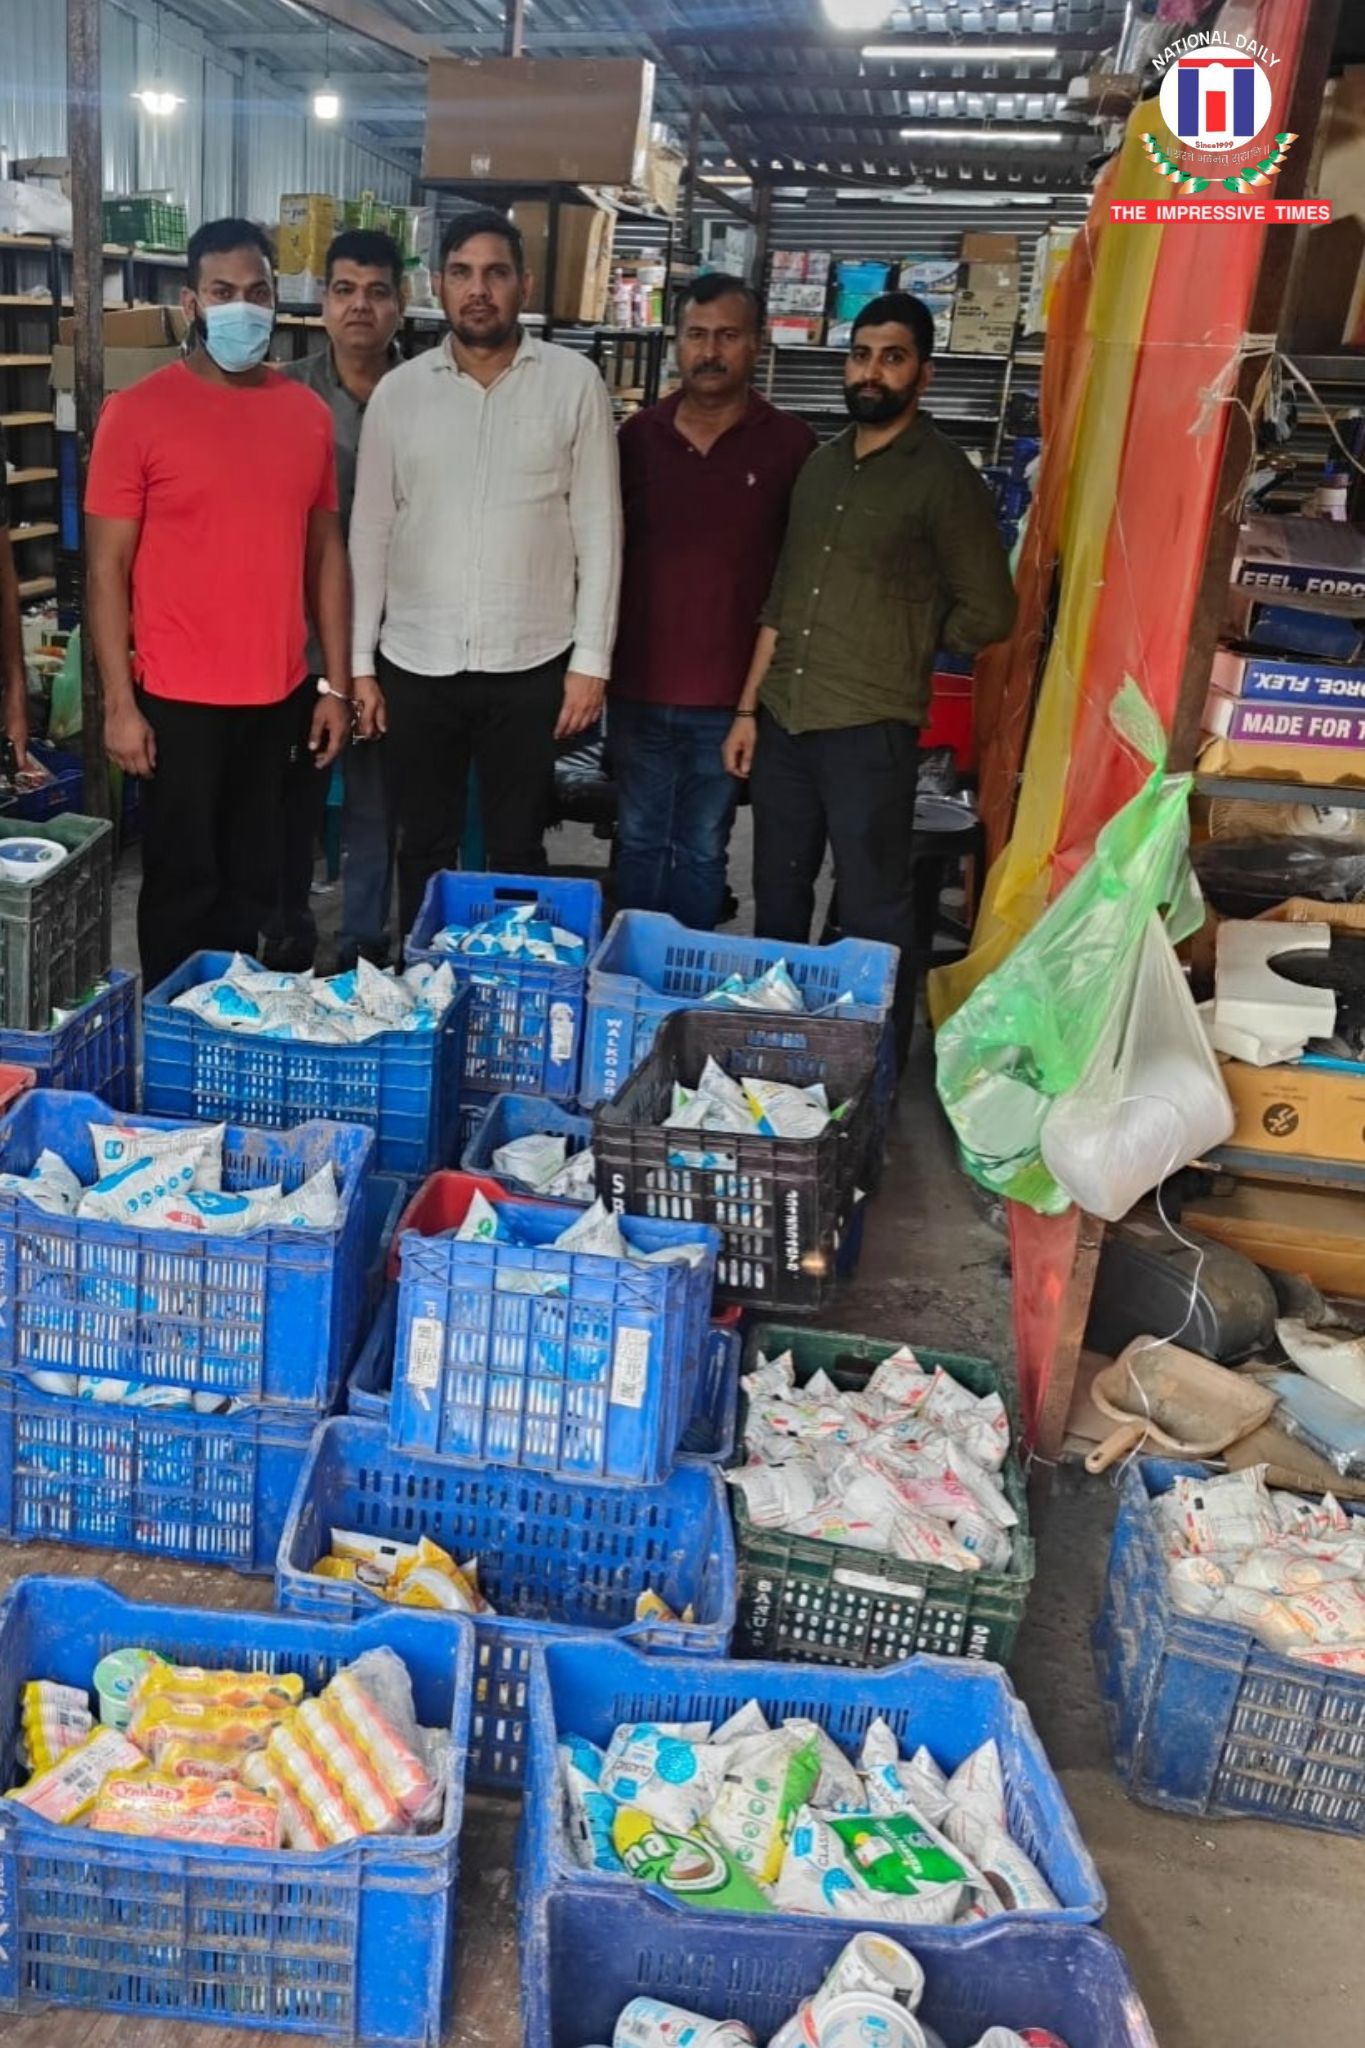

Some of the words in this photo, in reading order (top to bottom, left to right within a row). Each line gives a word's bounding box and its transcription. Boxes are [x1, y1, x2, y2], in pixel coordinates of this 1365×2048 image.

[1252, 672, 1311, 693] FLEX.
[1241, 712, 1304, 736] MADE
[1307, 716, 1352, 739] FOR
